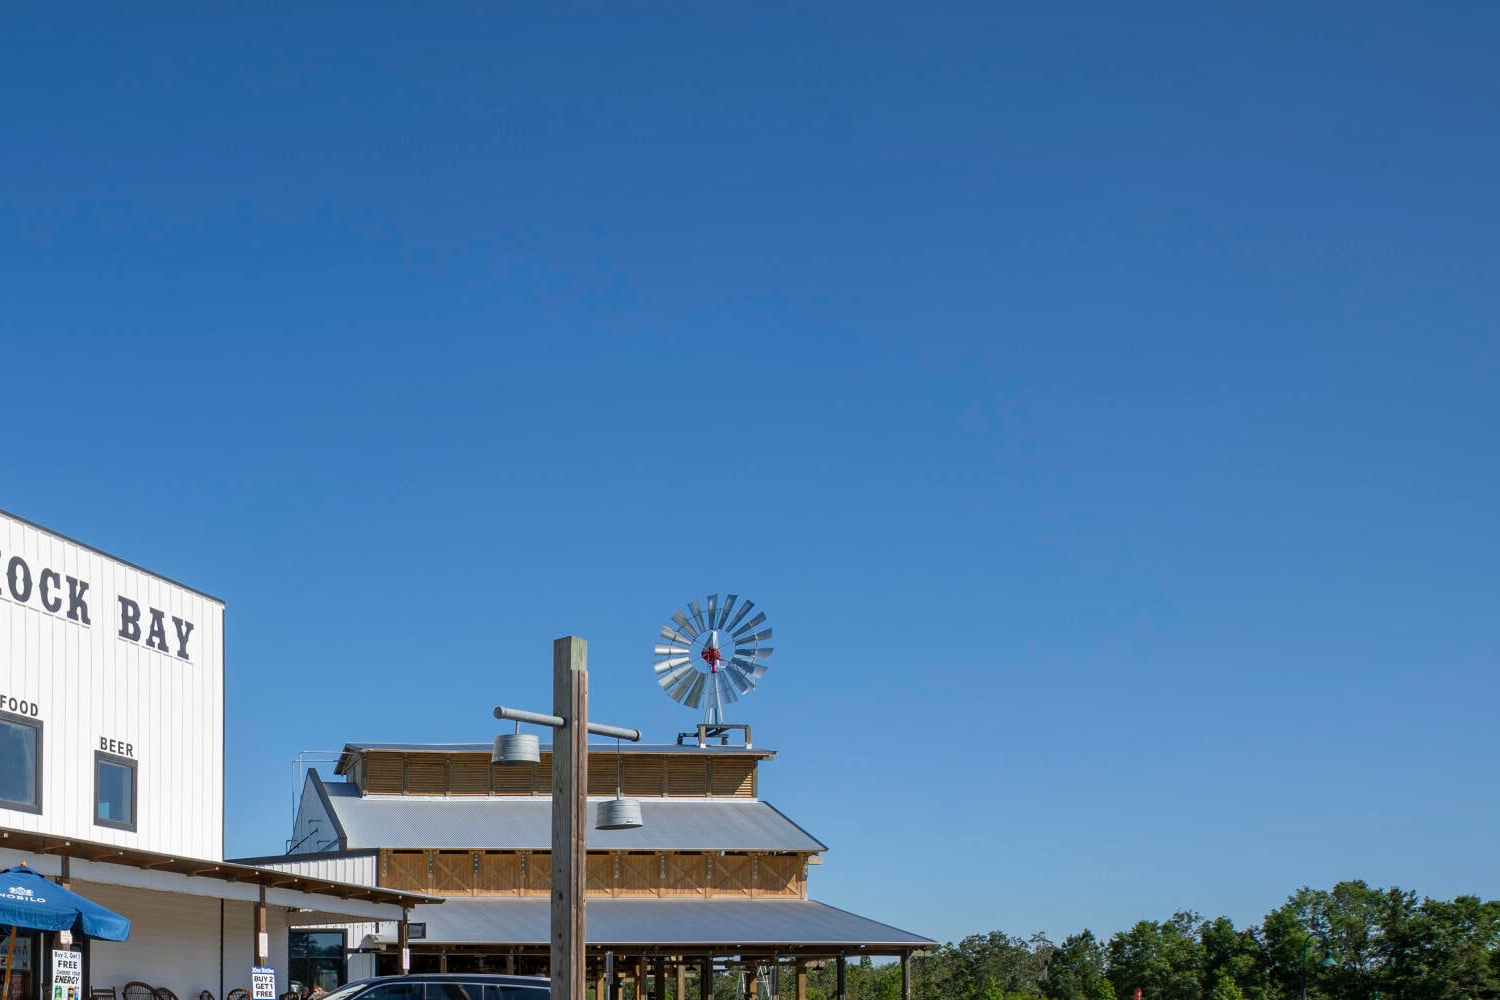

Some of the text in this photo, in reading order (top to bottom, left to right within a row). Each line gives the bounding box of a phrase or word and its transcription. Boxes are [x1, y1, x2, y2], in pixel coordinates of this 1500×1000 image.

[117, 595, 195, 660] BAY
[0, 694, 39, 717] FOOD
[100, 736, 134, 758] BEER
[57, 960, 78, 969] FREE
[54, 975, 80, 985] ENERGY
[256, 990, 273, 998] FREE
